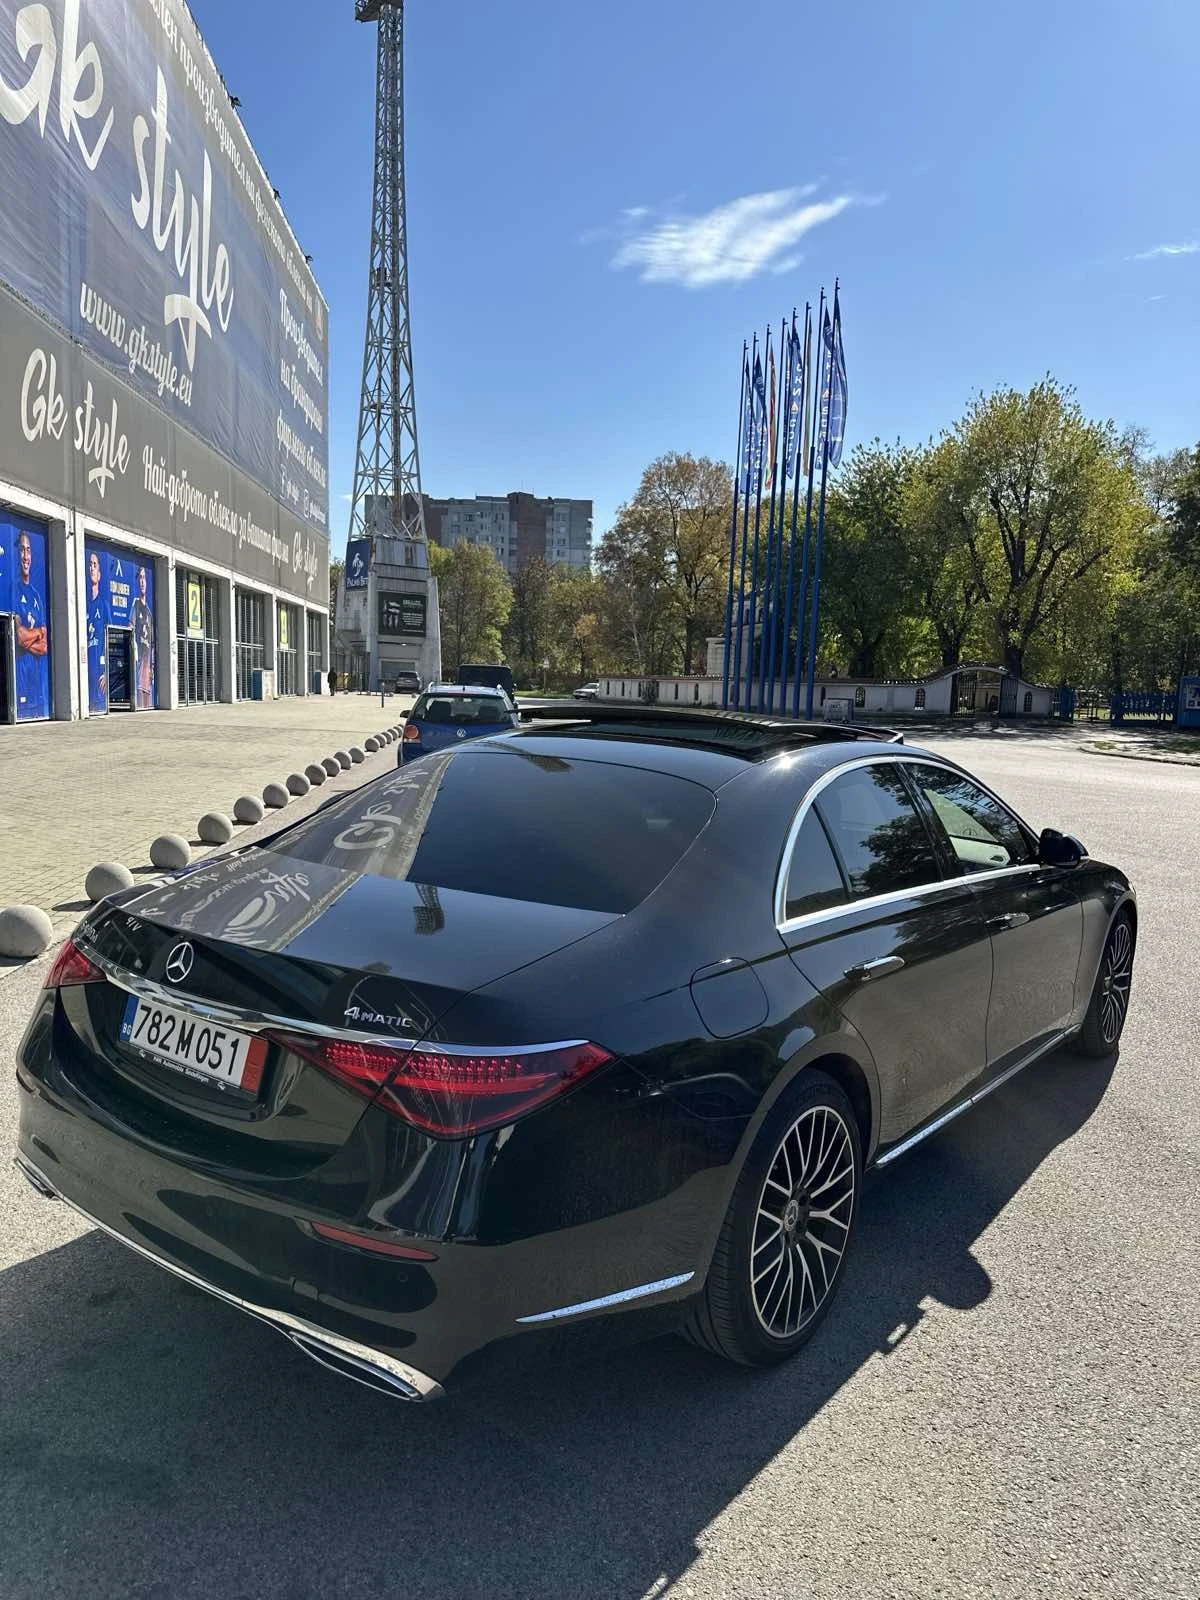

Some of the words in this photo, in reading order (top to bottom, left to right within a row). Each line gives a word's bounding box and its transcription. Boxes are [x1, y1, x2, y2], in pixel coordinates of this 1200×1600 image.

[179, 37, 246, 187] производител
[131, 64, 234, 372] style
[80, 282, 193, 407] www.gkstyle.eu
[21, 348, 68, 441] Gk
[74, 380, 131, 498] style
[142, 445, 207, 522] Най-доброто
[191, 590, 199, 622] 2
[122, 1024, 132, 1035] BG
[343, 1006, 413, 1028] 4MATIC
